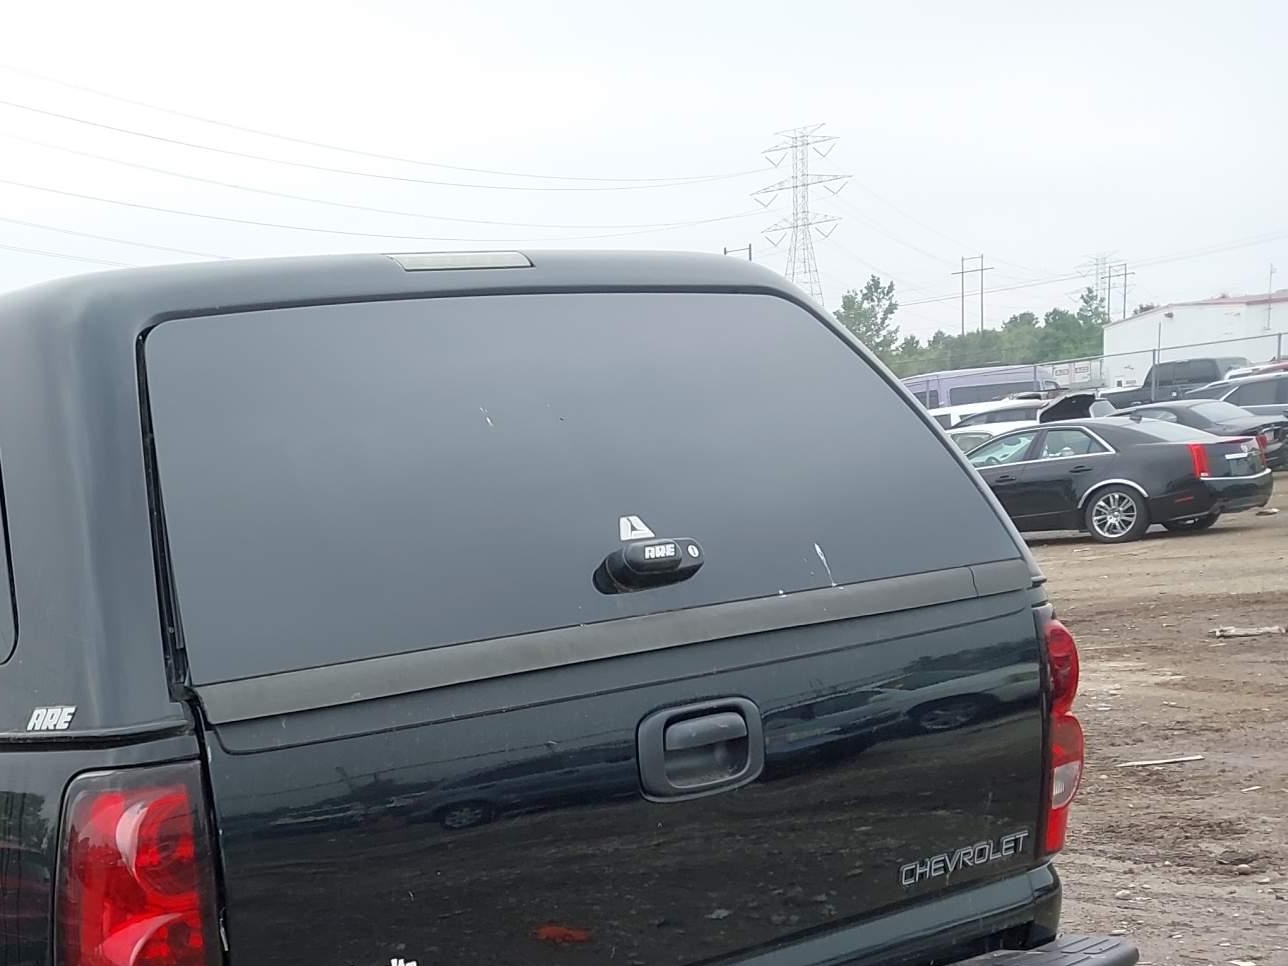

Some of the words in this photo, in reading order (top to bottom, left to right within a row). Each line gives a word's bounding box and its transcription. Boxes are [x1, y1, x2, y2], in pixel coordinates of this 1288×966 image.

[643, 543, 676, 560] ARE
[26, 706, 77, 731] ARE
[900, 830, 1029, 886] CHEVROLET
